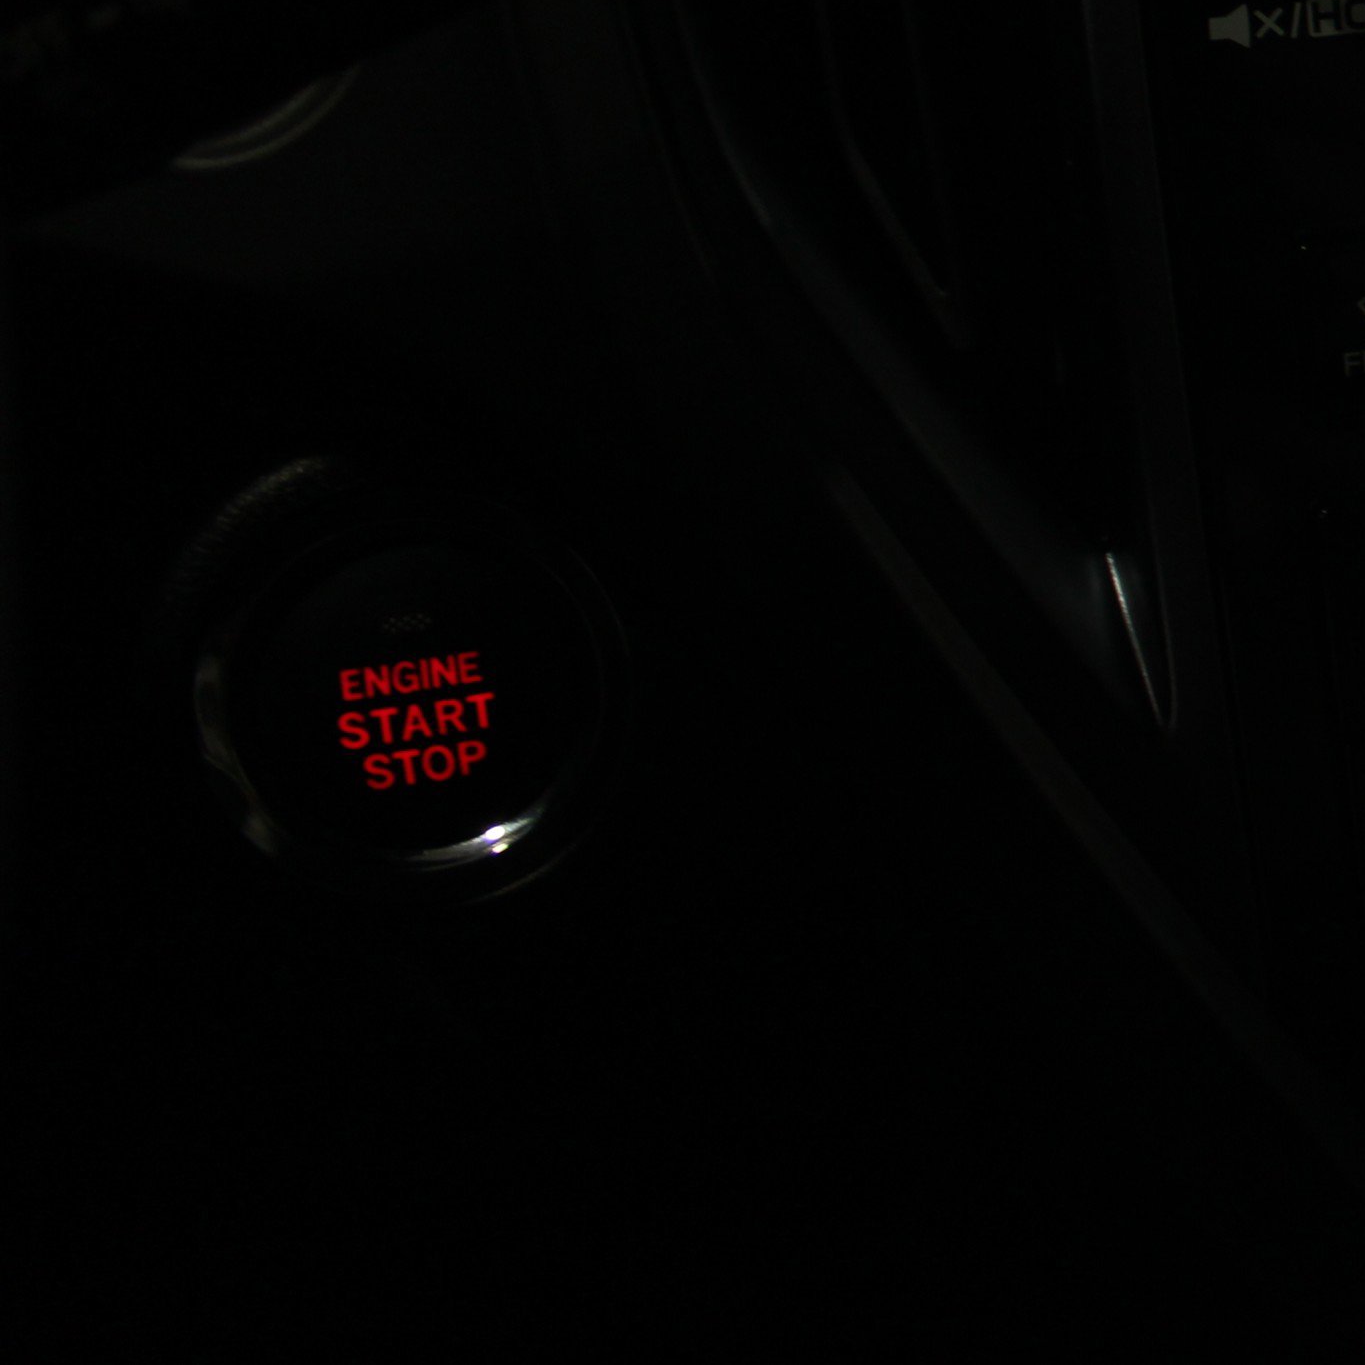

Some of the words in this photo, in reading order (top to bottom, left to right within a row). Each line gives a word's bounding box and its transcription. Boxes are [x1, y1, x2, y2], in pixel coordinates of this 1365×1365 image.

[338, 650, 484, 701] ENGINE
[337, 692, 496, 750] START
[361, 740, 488, 790] STOP
